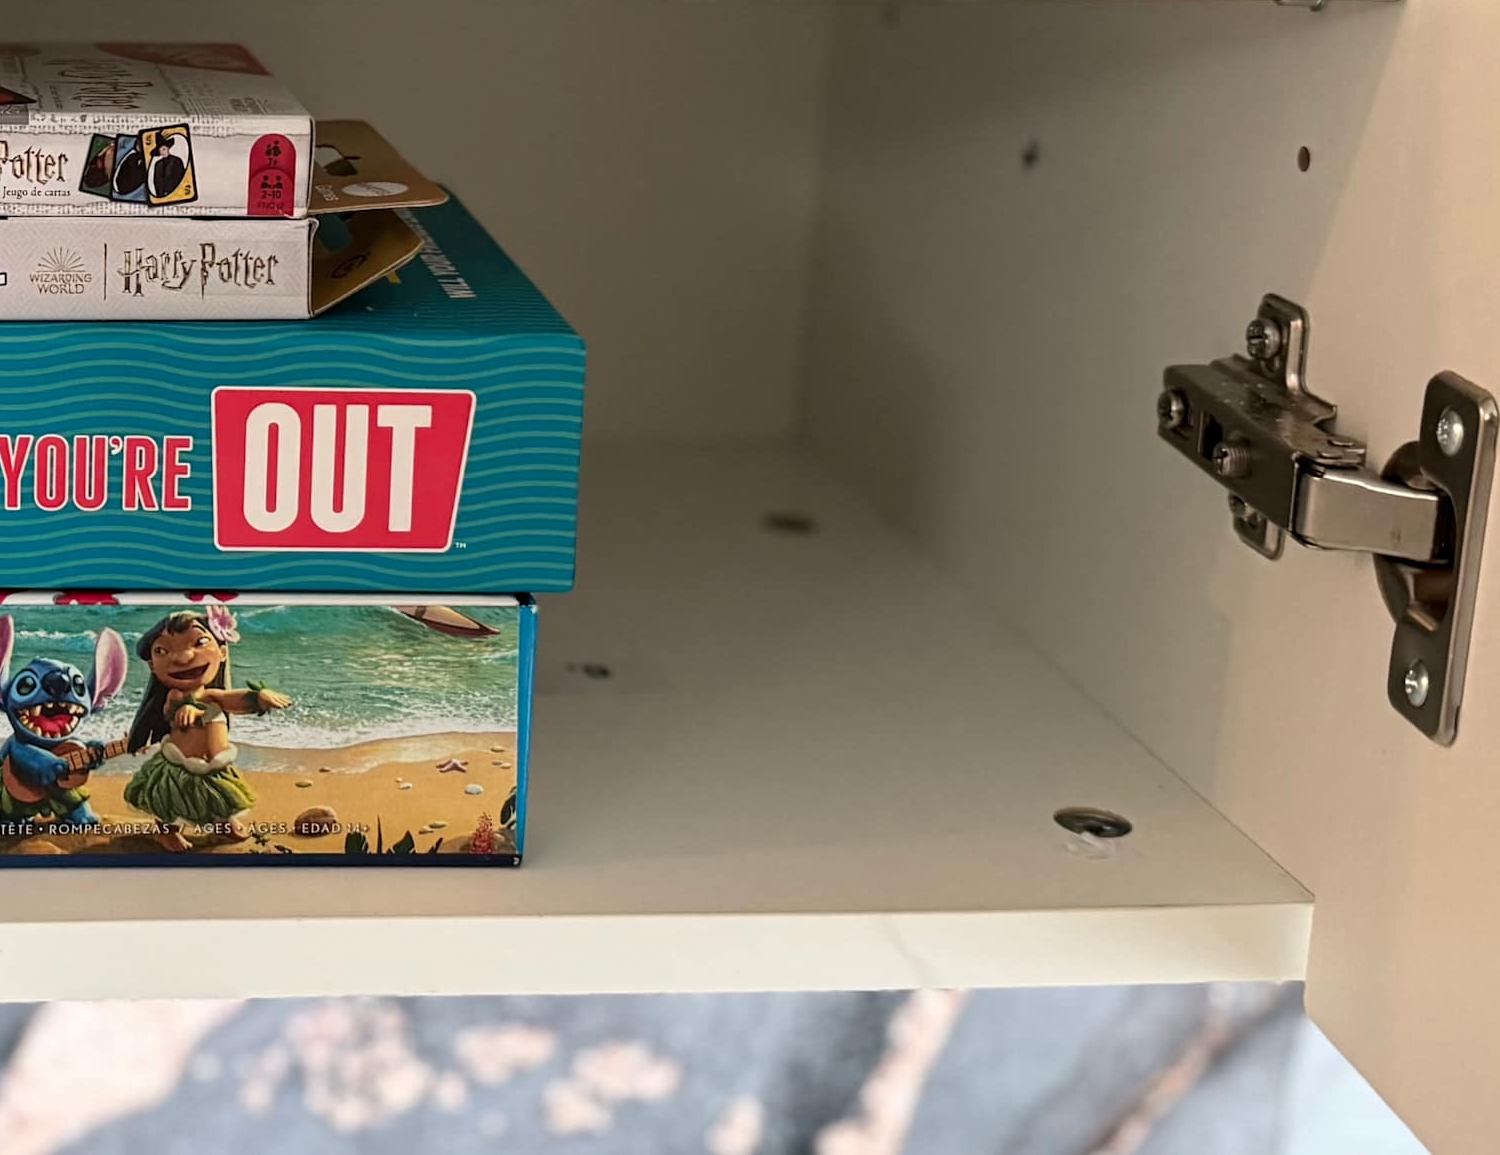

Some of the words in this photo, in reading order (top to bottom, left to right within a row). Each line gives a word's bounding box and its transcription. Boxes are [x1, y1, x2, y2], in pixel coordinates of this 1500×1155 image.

[30, 185, 43, 197] de
[45, 186, 71, 198] cartas
[261, 190, 282, 199] 2-10
[117, 247, 194, 296] Harry
[197, 242, 279, 299] Potter
[28, 272, 93, 284] WIZARDING
[36, 283, 85, 295] WORLD
[242, 401, 433, 534] OUT
[49, 823, 170, 835] ROMPECABEZAS
[193, 823, 232, 834] AGES
[301, 823, 341, 834] EDAD
